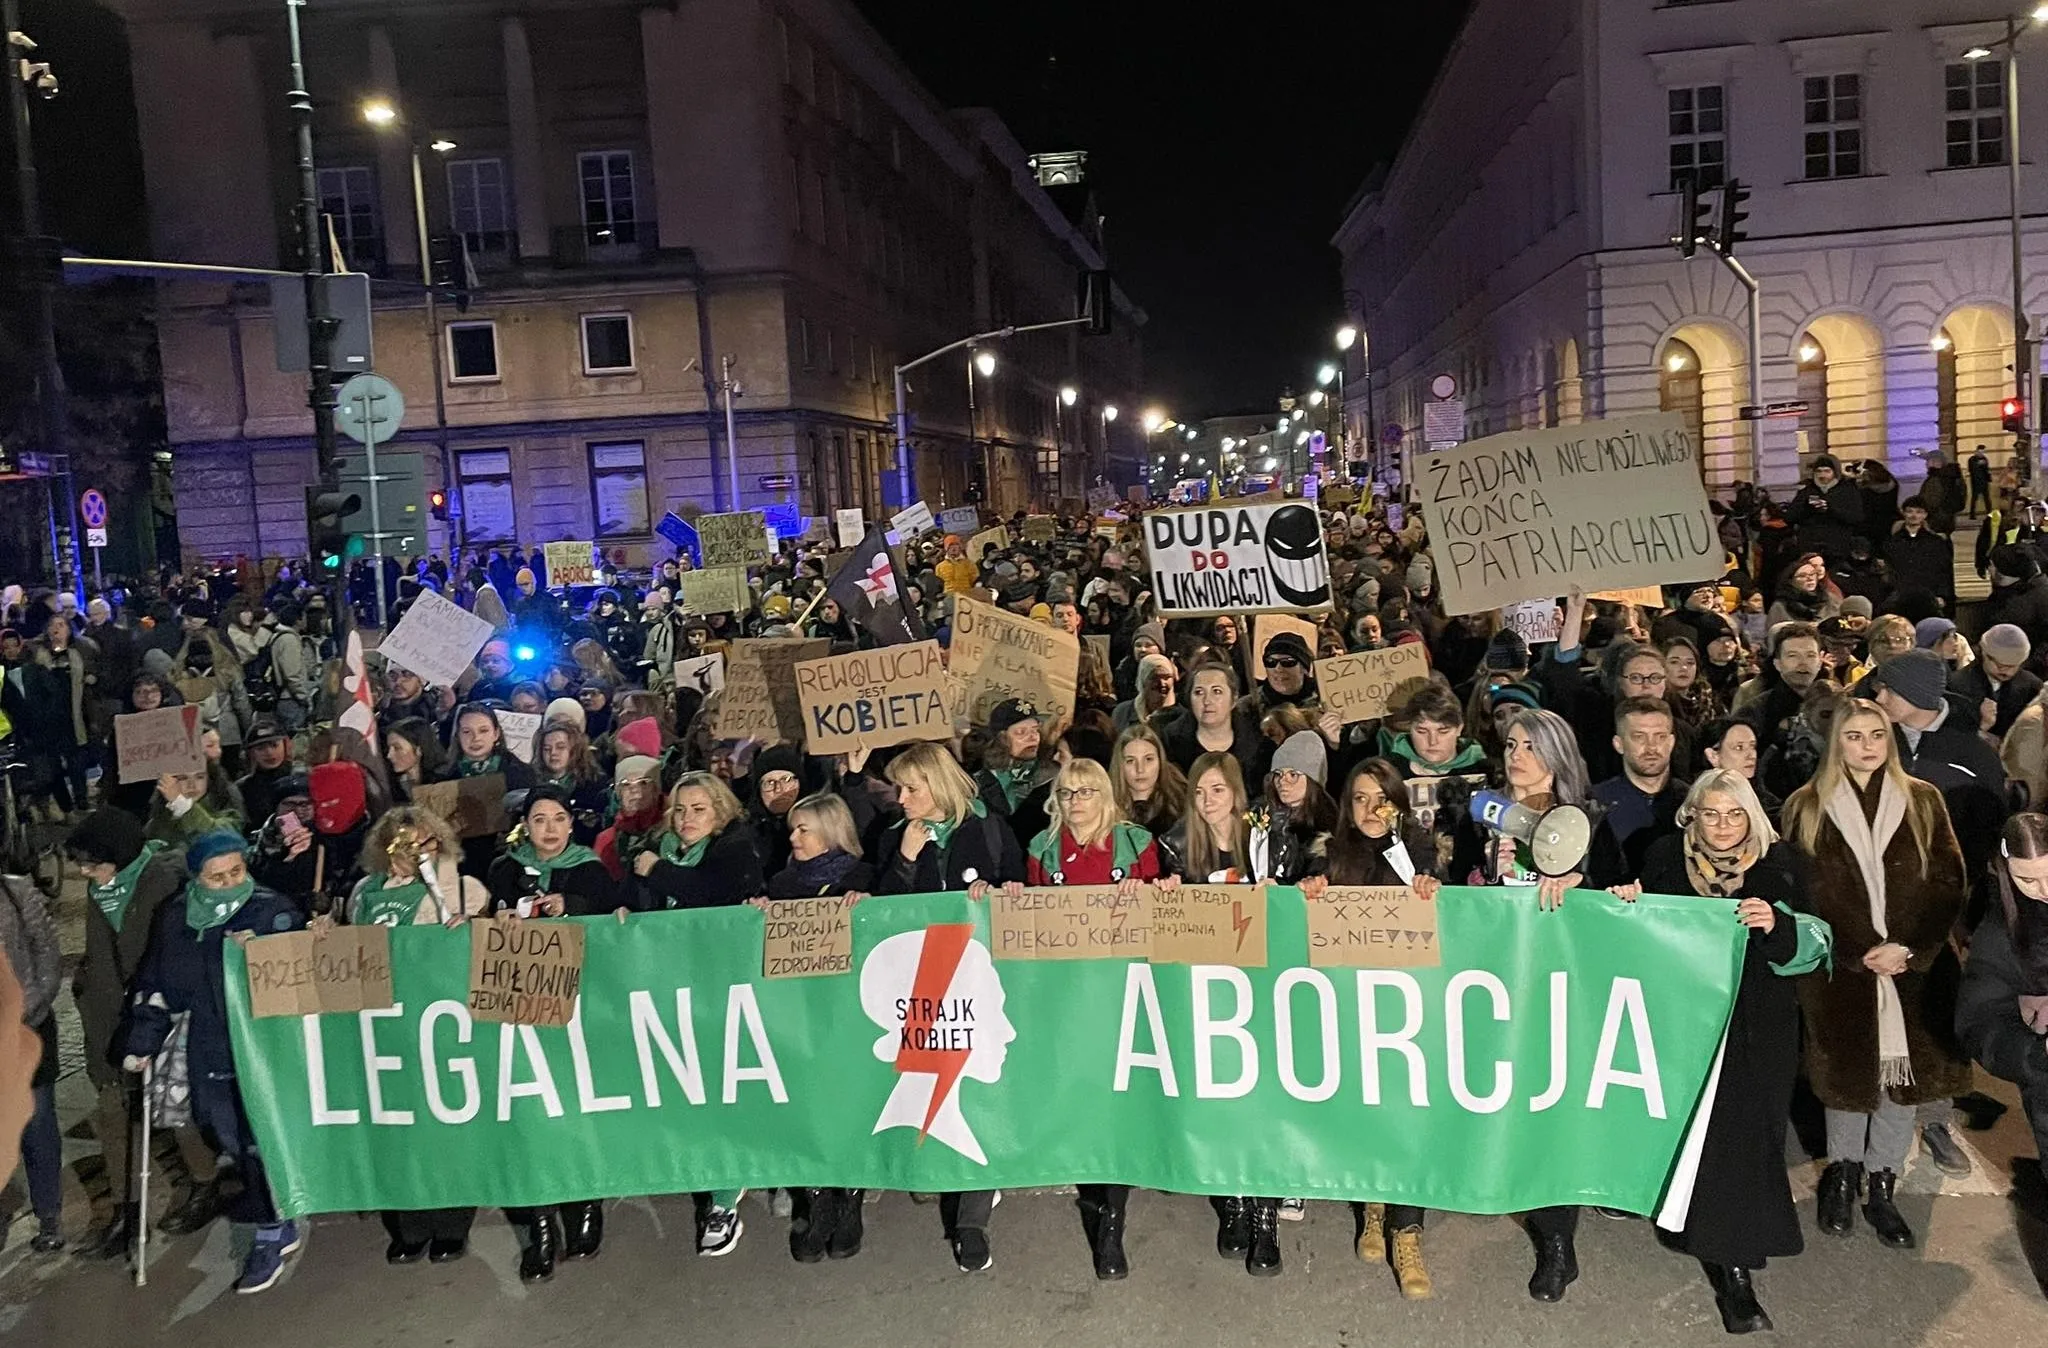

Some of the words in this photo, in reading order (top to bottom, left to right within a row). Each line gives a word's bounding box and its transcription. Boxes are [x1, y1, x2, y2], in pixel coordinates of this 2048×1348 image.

[1429, 446, 1542, 502] ŻĄDAM
[1440, 489, 1553, 539] KOŃCA
[1151, 509, 1260, 549] DUPA
[1191, 550, 1230, 571] DO
[1448, 509, 1710, 589] PATRIARCHATU
[1156, 567, 1271, 608] LIKWIDACJI
[956, 597, 974, 633] 8
[1504, 611, 1545, 626] MOJA
[953, 639, 982, 660] NIE
[797, 646, 943, 695] REWOLUCJA
[1324, 646, 1420, 683] SZYMON
[857, 685, 887, 699] JEST
[771, 900, 842, 920] CHCEMY
[995, 892, 1072, 913] TRZECIA
[1086, 890, 1141, 909] DROGA
[767, 919, 849, 940] ZDROWIA
[1064, 912, 1089, 925] TO
[487, 927, 562, 958] DUDA
[790, 937, 816, 954] NIE
[1089, 926, 1151, 945] KOBIET
[481, 959, 580, 1000] HOŁOWNIA
[470, 990, 514, 1013] JEDNA
[514, 994, 563, 1025] DUPA
[896, 998, 976, 1022] STRAJK
[302, 983, 790, 1126] LEGALNA
[1112, 962, 1668, 1119] ABORCJA
[900, 1027, 974, 1051] KOBIET
